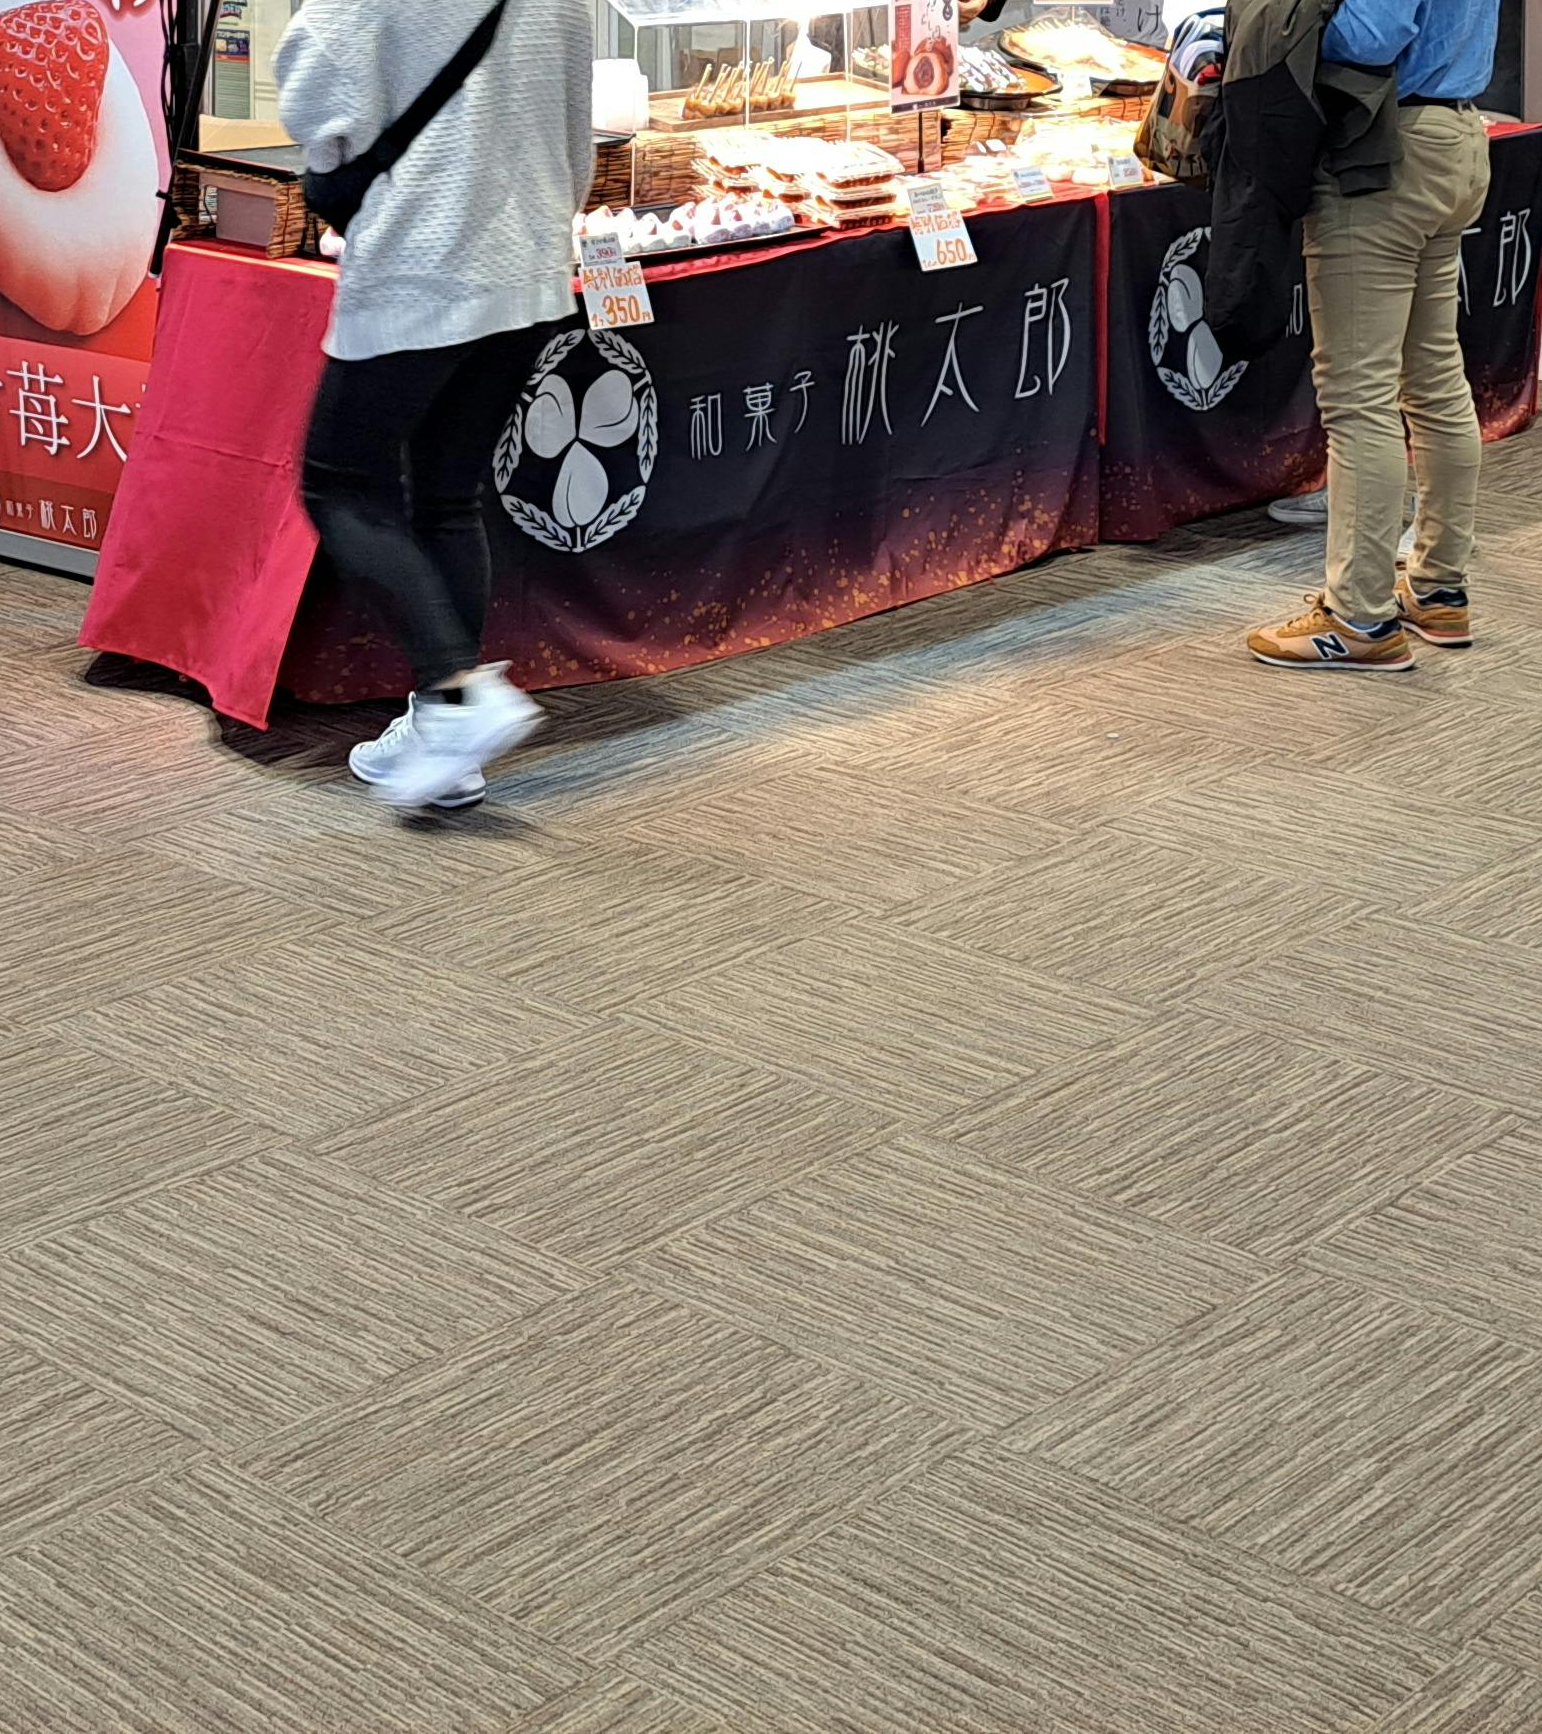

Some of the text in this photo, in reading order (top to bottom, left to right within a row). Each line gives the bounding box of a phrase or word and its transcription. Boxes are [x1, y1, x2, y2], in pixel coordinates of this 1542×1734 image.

[689, 369, 817, 460] 和菓子
[841, 277, 1072, 446] 桃太郎
